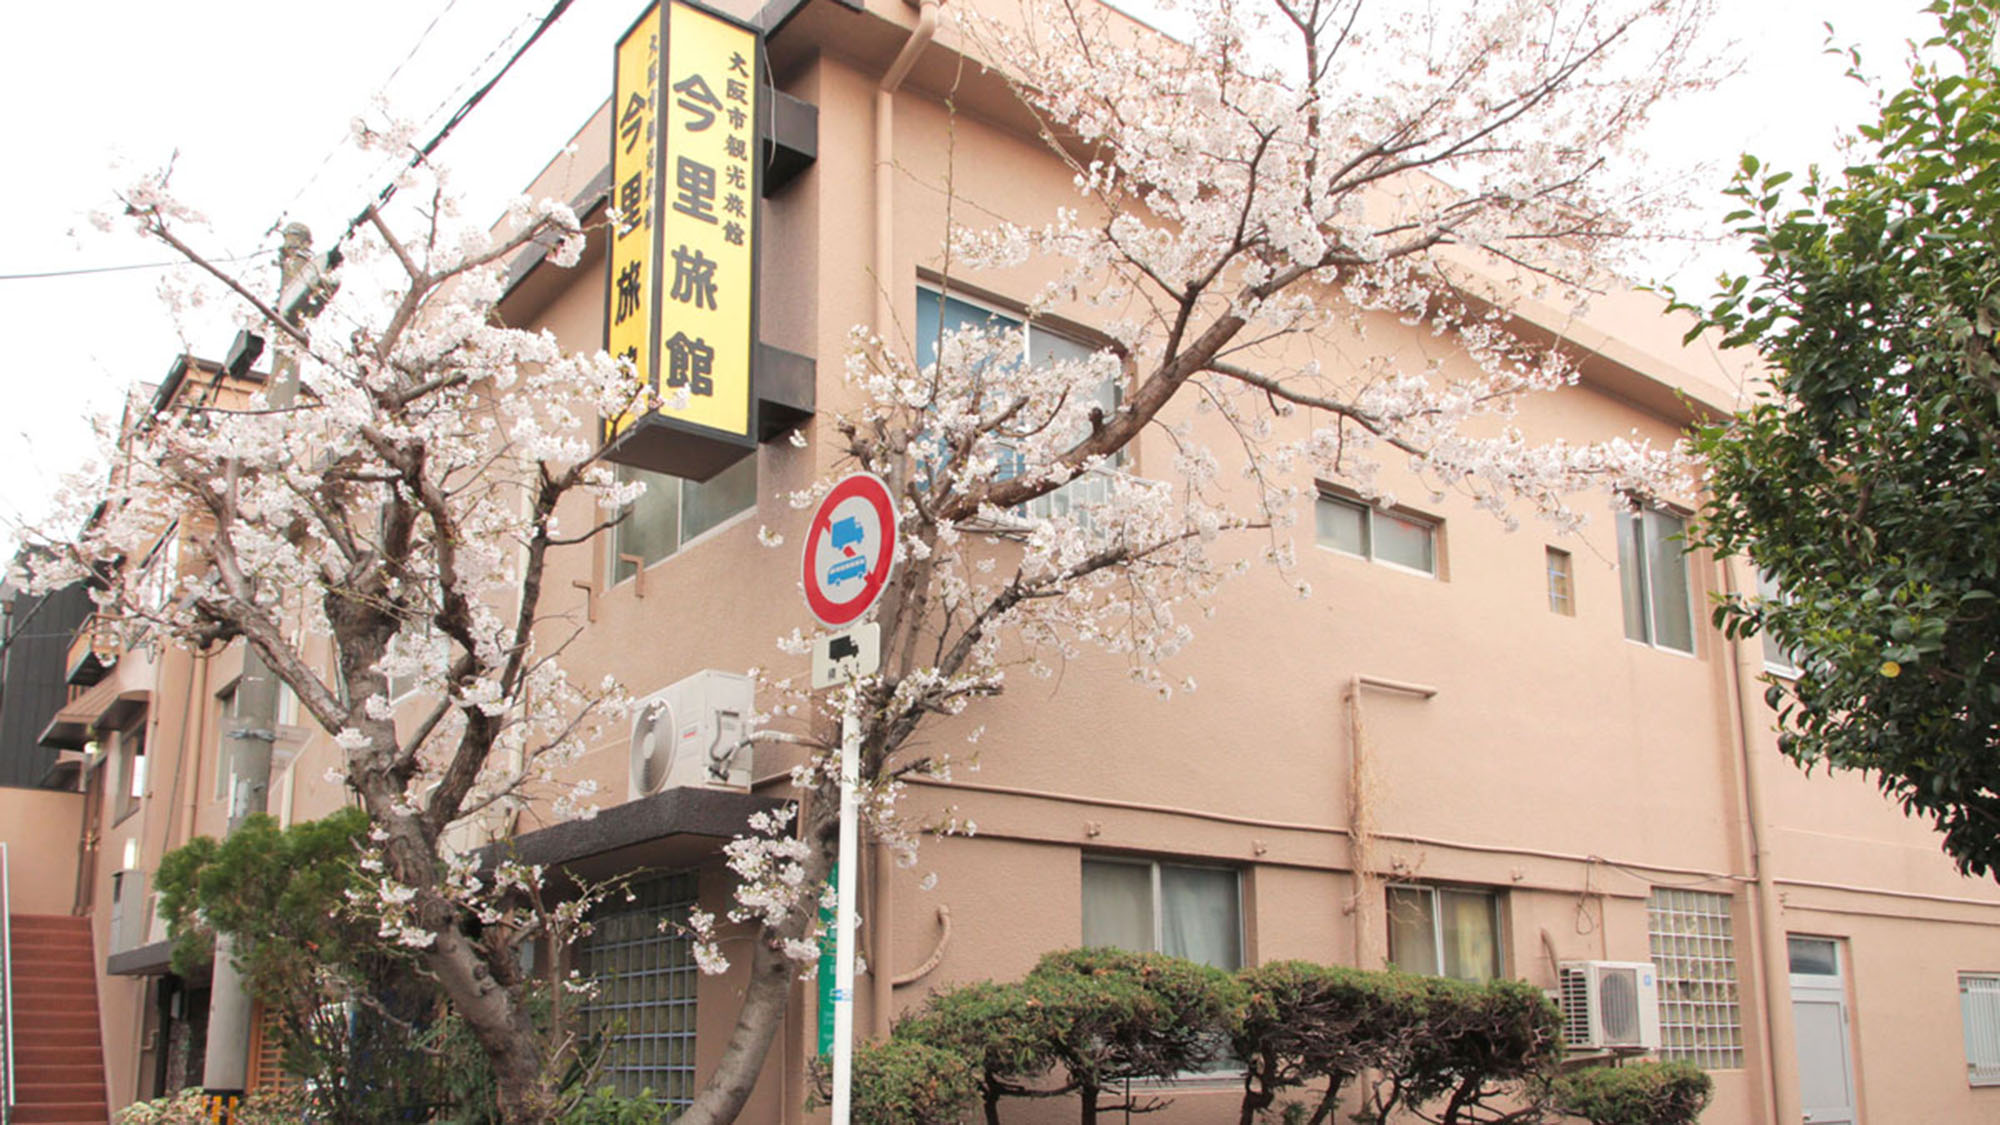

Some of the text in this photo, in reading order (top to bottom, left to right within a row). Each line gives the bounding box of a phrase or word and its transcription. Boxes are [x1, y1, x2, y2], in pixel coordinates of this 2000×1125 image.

[615, 91, 646, 378] 今里旅
[665, 73, 724, 397] 今里旅館
